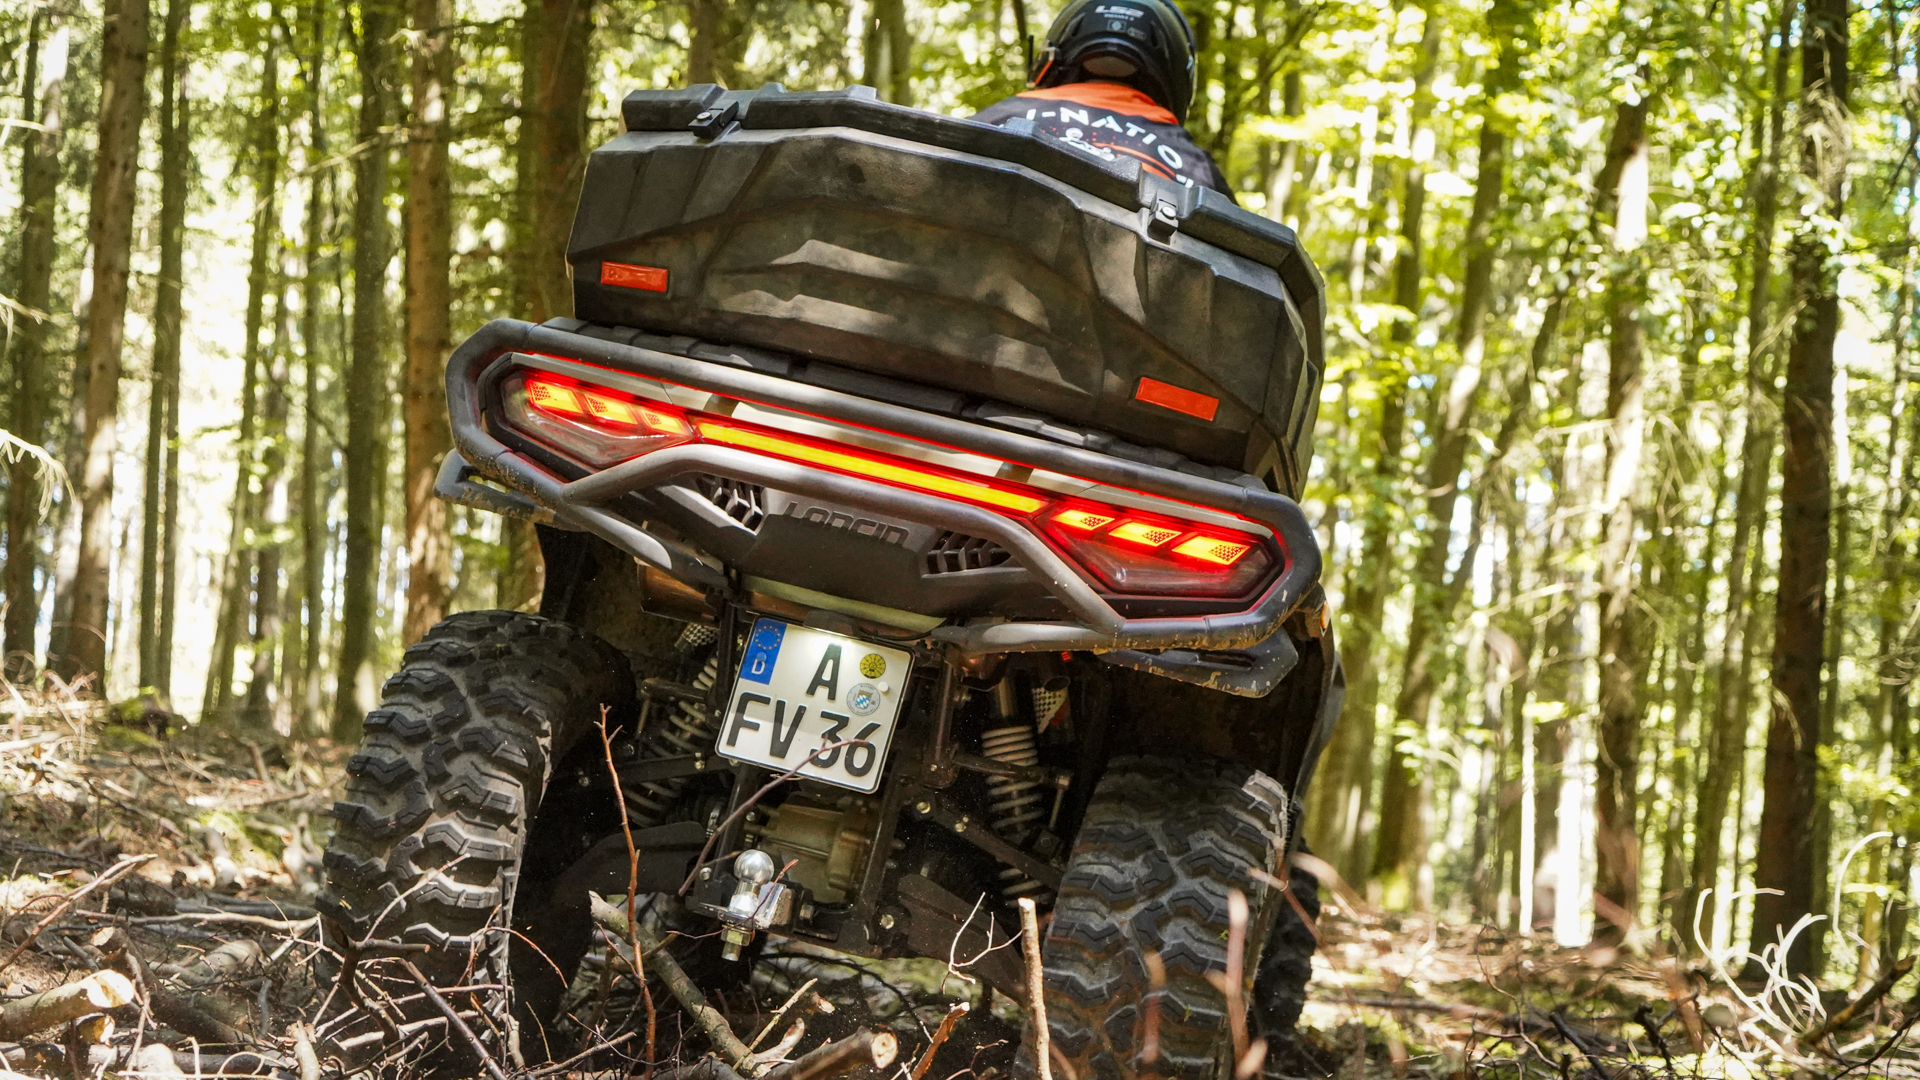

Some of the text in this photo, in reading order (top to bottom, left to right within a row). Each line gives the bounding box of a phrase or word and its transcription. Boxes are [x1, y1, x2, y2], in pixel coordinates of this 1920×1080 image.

[783, 501, 910, 547] LONCIN
[751, 658, 765, 675] D
[805, 642, 842, 701] A
